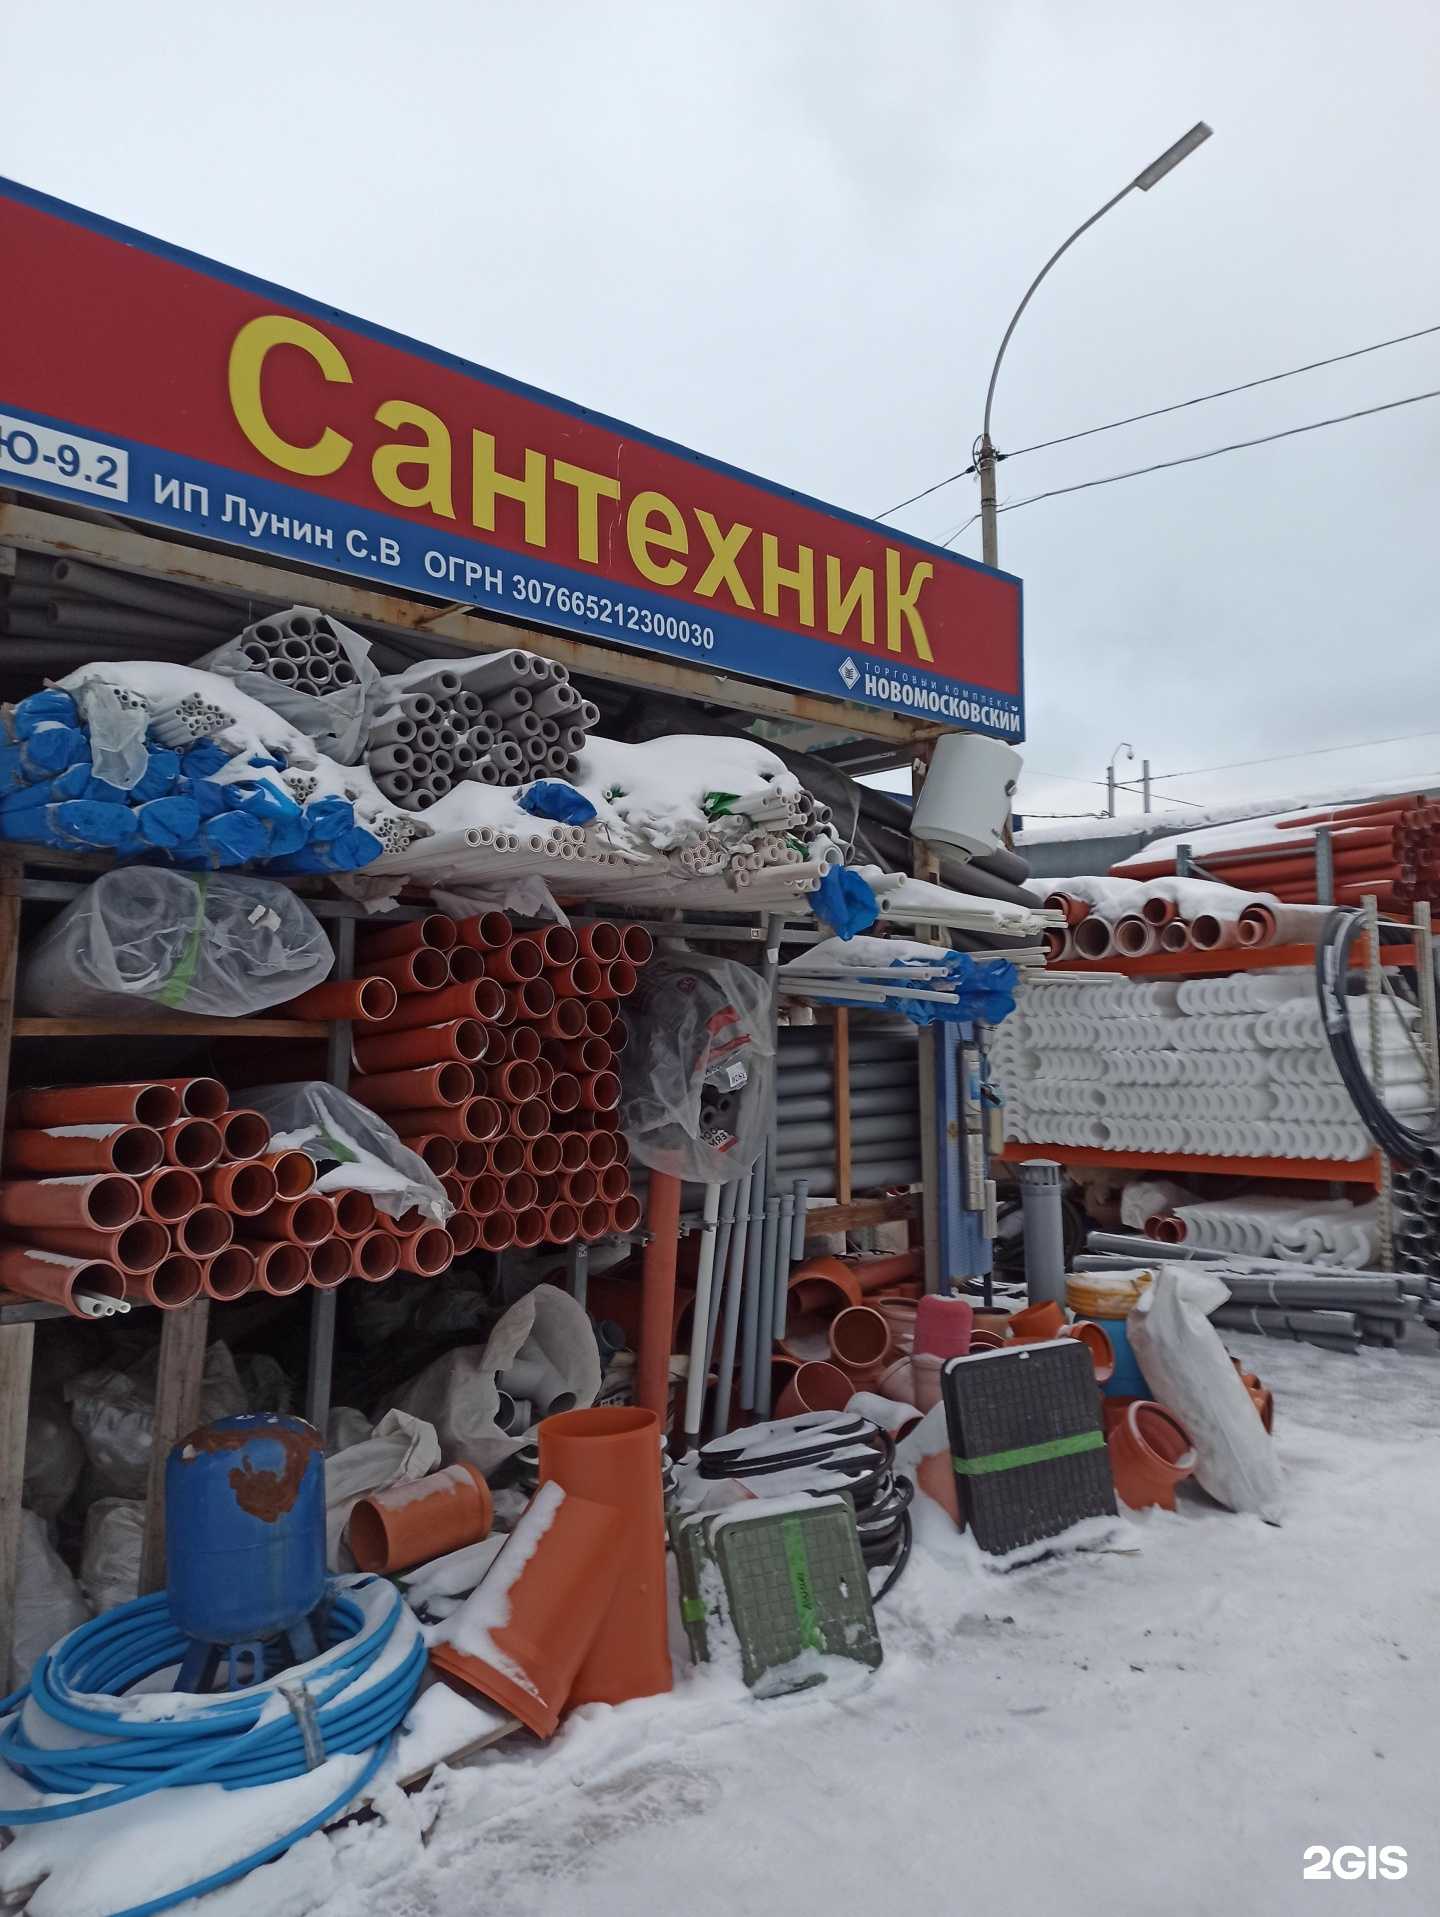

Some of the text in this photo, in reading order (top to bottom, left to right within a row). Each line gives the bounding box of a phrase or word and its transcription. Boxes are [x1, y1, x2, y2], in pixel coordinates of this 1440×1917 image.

[153, 473, 715, 650] ИП Лунин С.В ОГРН 307665212300030
[865, 673, 1021, 733] НОВОМОСКОВСКИЙ
